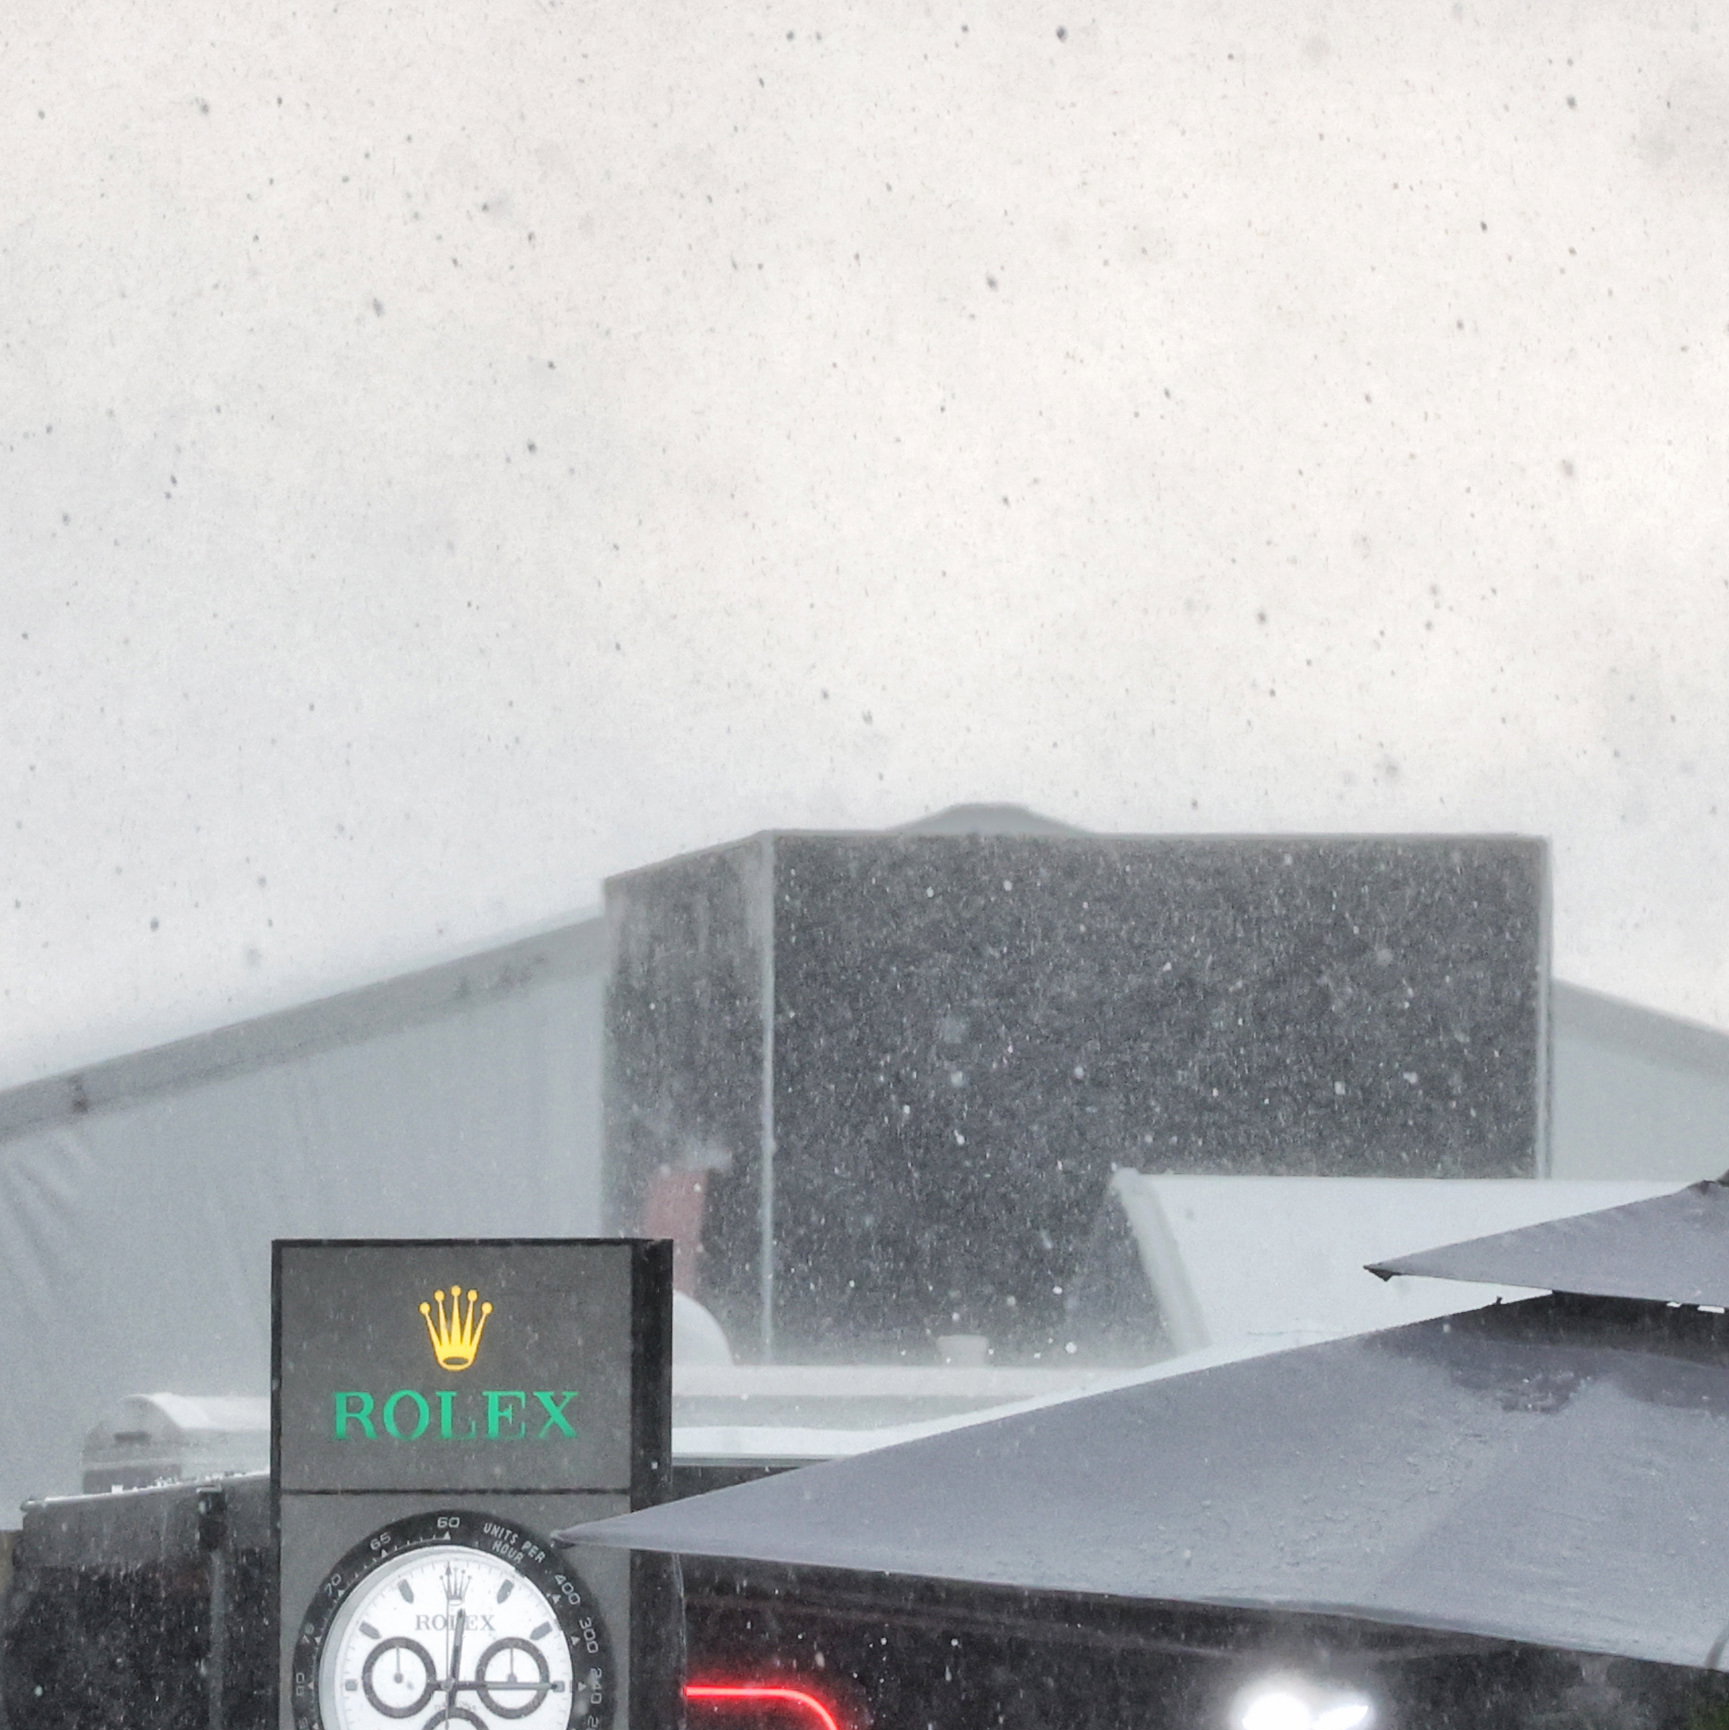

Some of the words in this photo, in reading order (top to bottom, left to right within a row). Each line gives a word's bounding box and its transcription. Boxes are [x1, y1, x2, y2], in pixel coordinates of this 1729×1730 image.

[333, 1389, 580, 1442] ROLEX
[436, 1516, 460, 1529] 60
[369, 1532, 392, 1551] 65
[483, 1522, 519, 1545] UNITS
[522, 1540, 546, 1564] PER
[492, 1540, 525, 1565] HOUR
[324, 1573, 342, 1597] 70
[554, 1574, 581, 1605] 400
[579, 1617, 599, 1654] 300
[589, 1667, 603, 1705] 240
